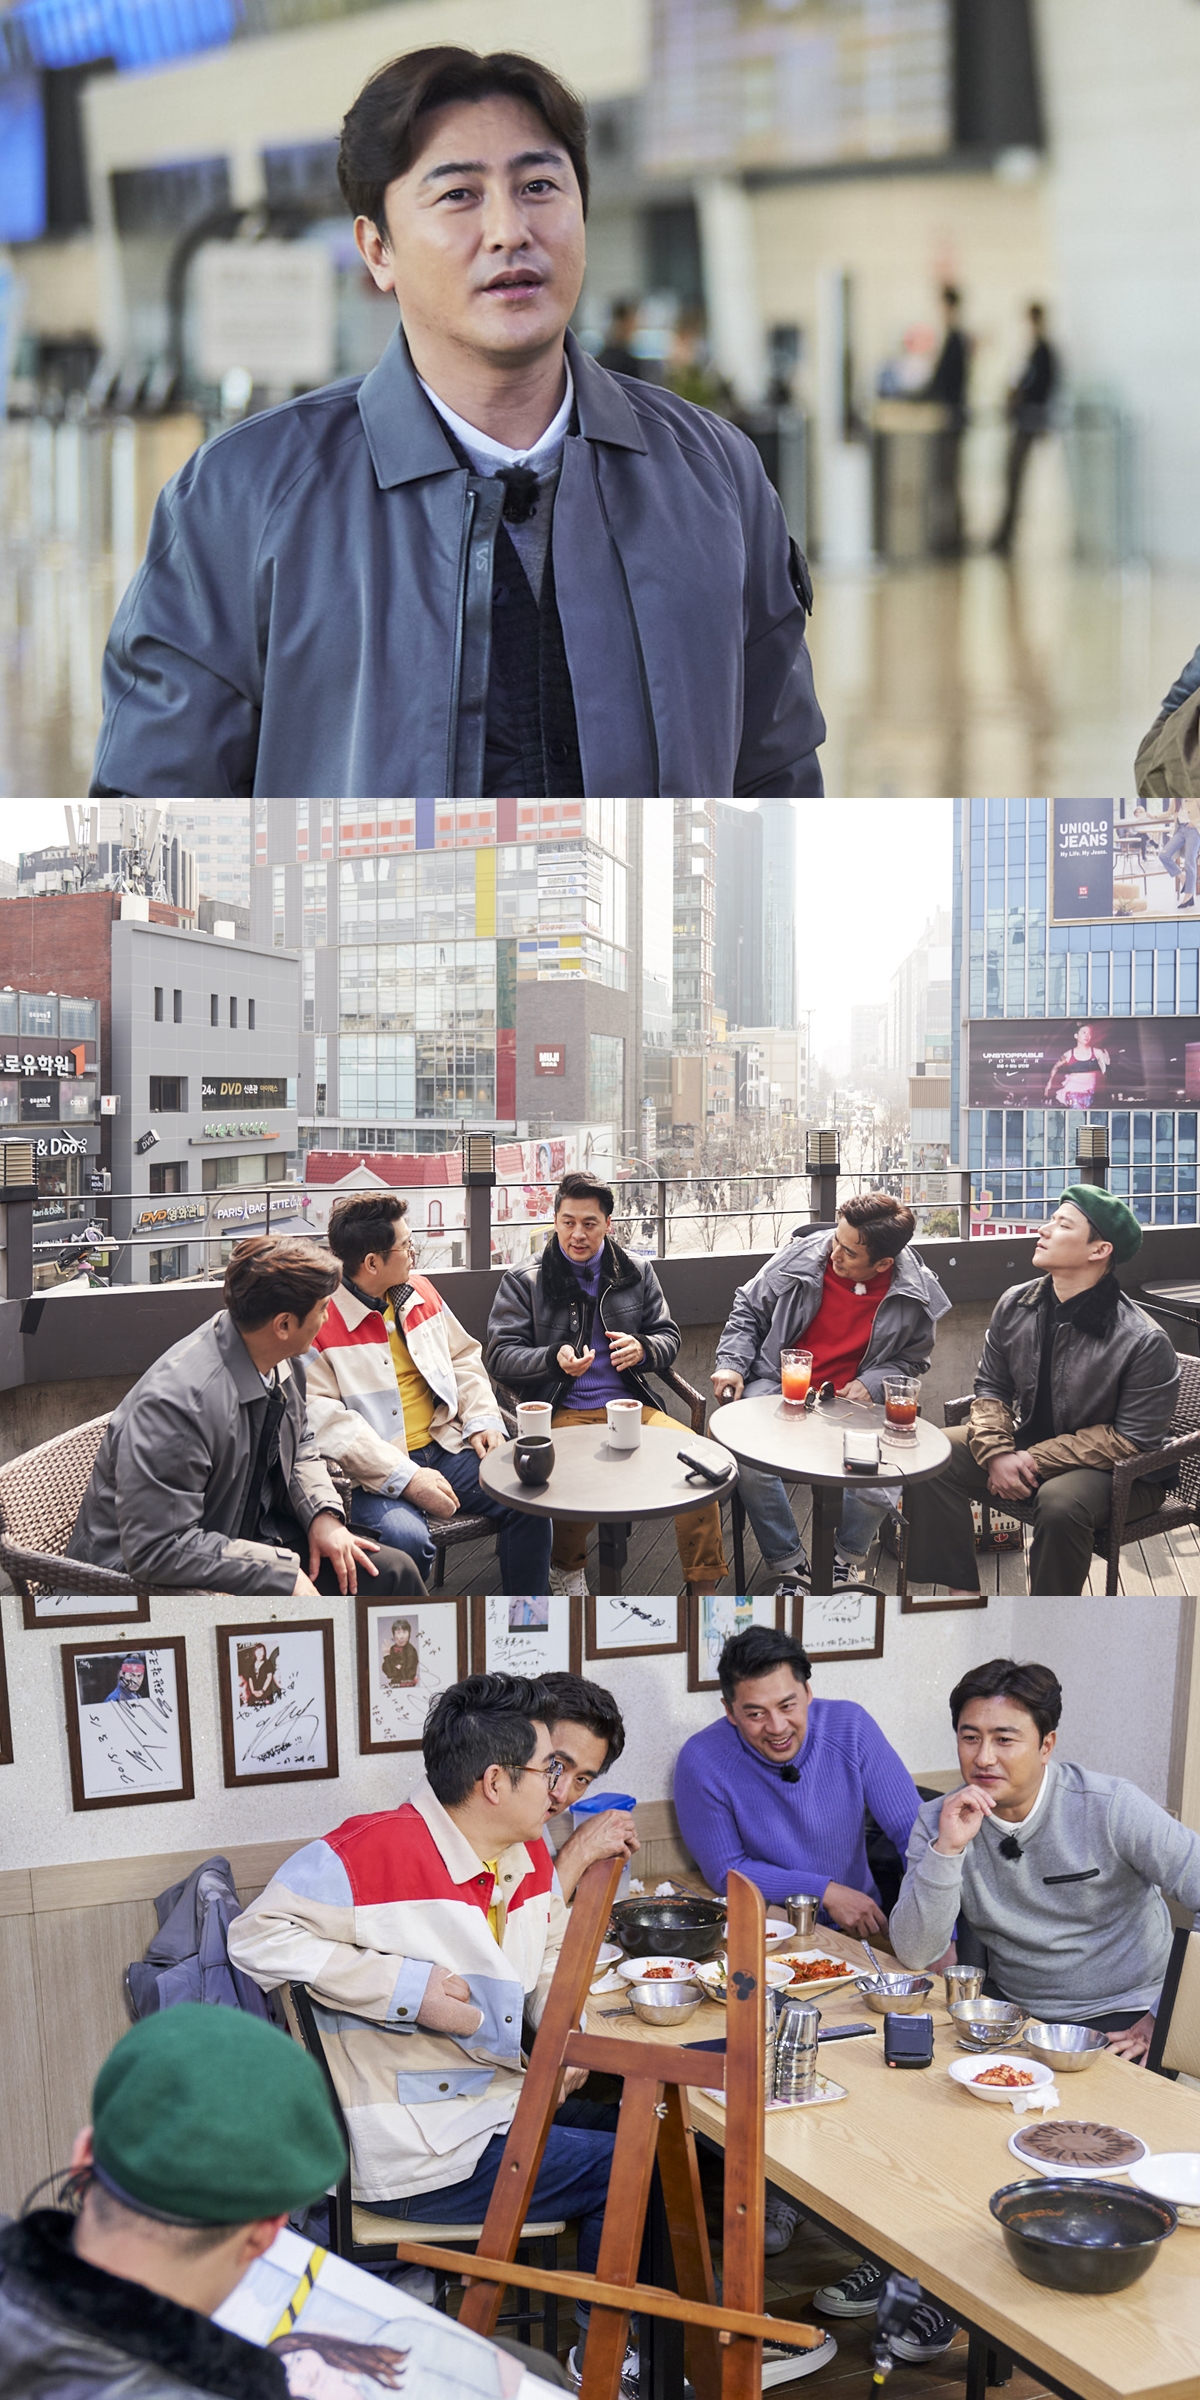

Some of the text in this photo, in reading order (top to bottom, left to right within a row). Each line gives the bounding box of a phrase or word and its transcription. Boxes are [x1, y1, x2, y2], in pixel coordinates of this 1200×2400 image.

[1059, 820, 1108, 835] UNIQLO
[1059, 833, 1108, 849] JEANS
[570, 969, 580, 978] PC
[539, 1052, 560, 1062] MUJI
[202, 1084, 216, 1096] 24시
[220, 1082, 242, 1096] DVD
[141, 1135, 155, 1150] DVD
[217, 1208, 244, 1220] PARIS
